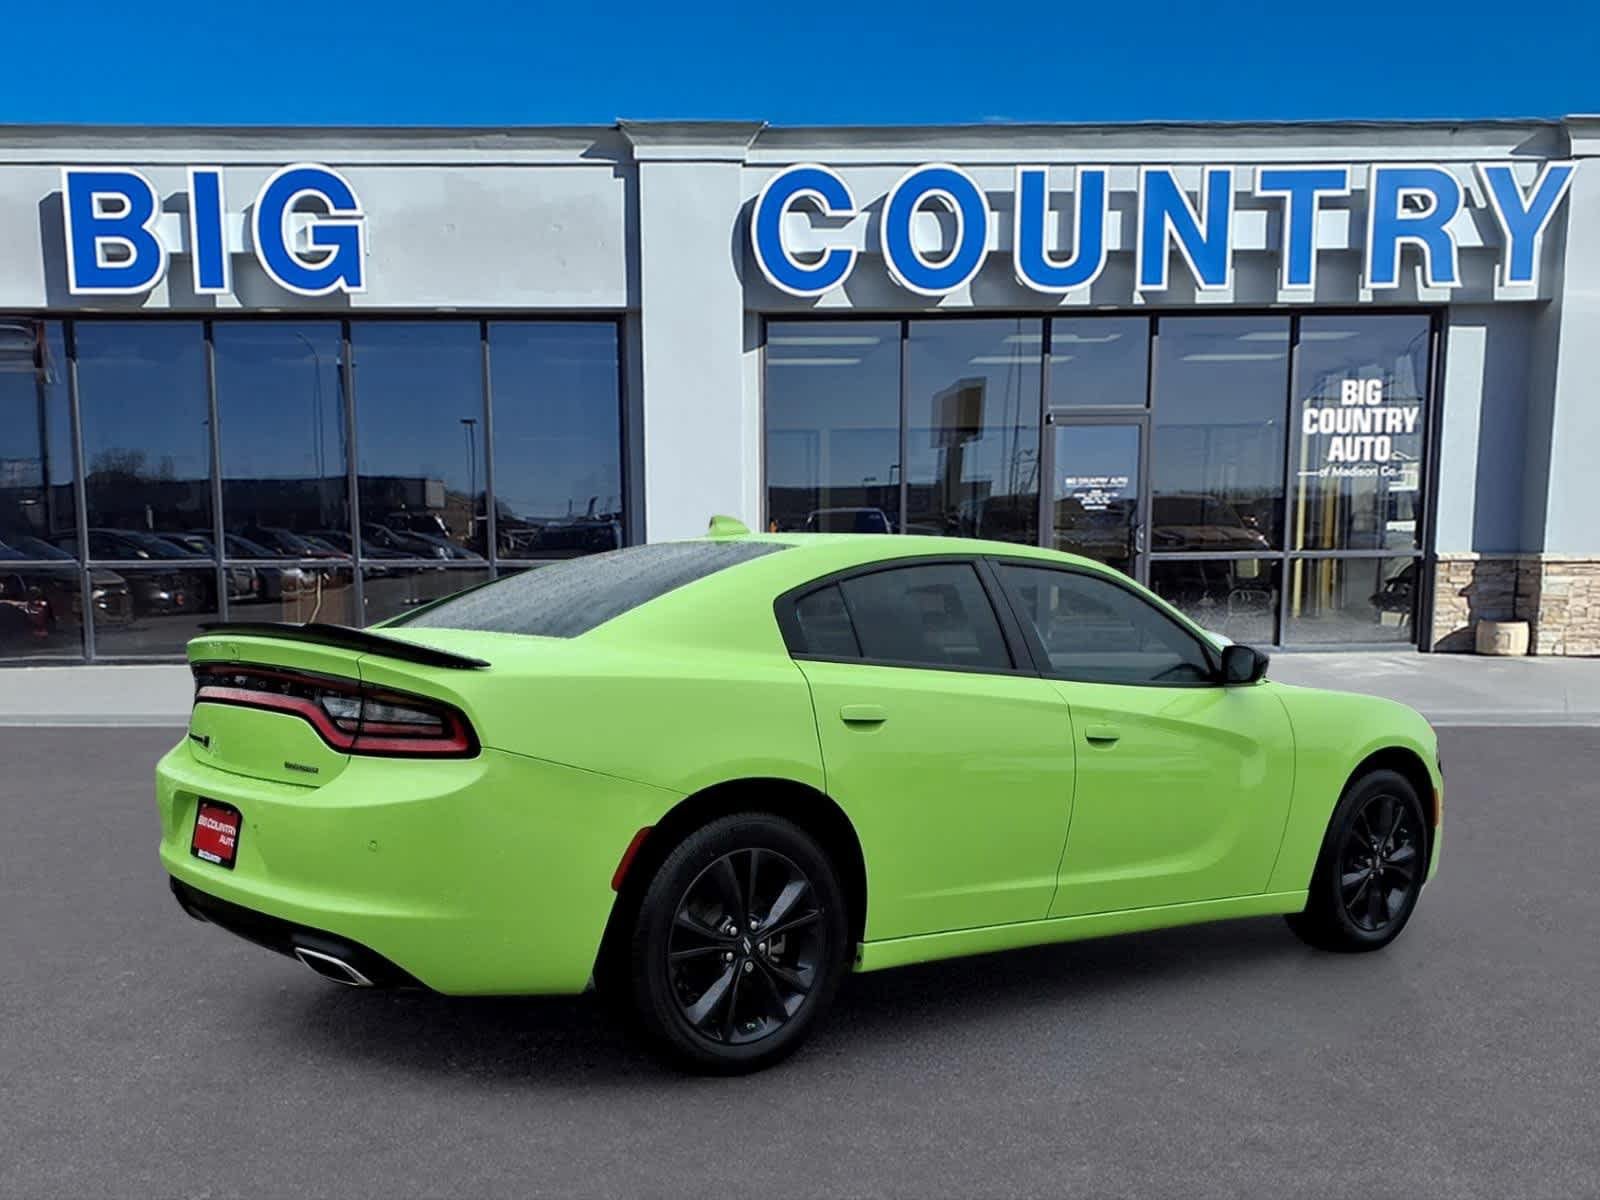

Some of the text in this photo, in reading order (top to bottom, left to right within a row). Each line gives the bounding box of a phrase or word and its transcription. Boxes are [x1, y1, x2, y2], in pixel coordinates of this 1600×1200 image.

[61, 161, 1577, 298] BIG COUNTRY
[1341, 379, 1382, 405] BIG
[1303, 407, 1419, 434] COUNTRY
[1327, 436, 1391, 462] AUTO
[1332, 466, 1378, 477] Madison
